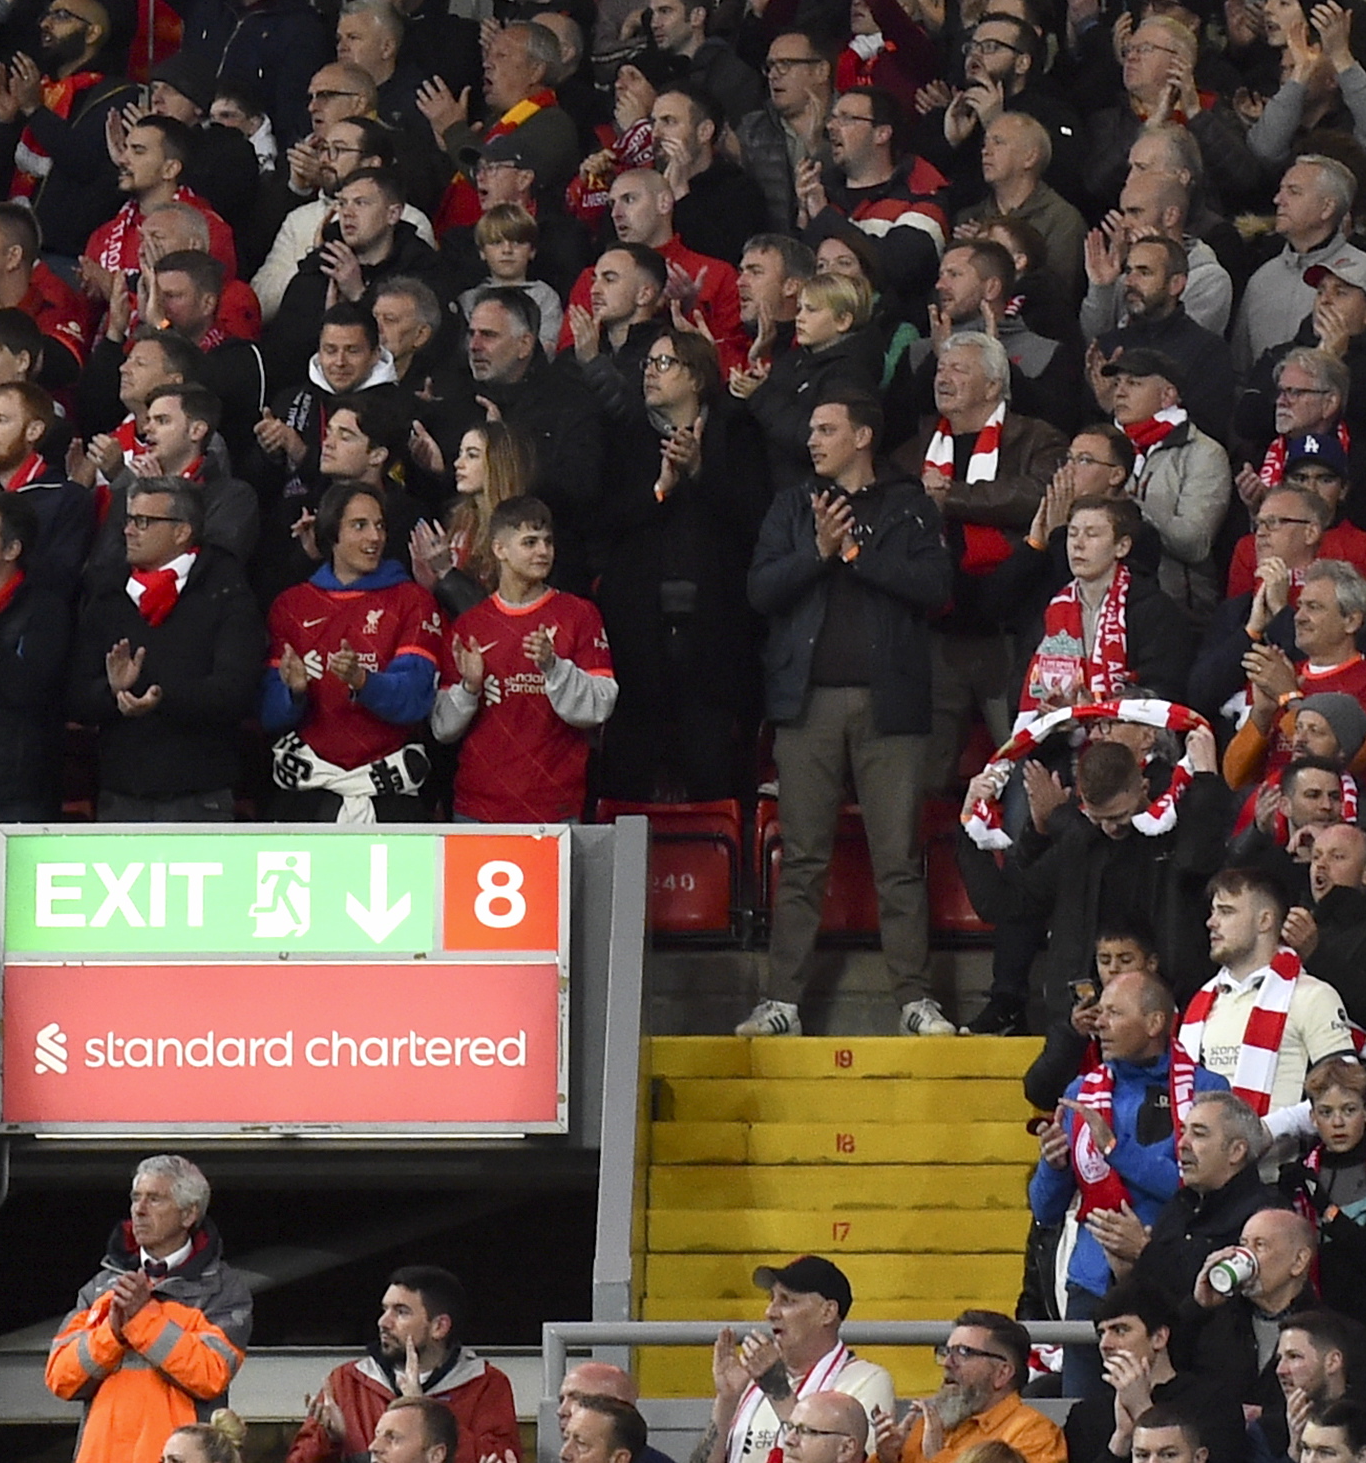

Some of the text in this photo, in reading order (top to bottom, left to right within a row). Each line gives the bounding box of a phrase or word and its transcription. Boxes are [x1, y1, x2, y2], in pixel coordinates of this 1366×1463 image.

[36, 860, 527, 929] EXIT 8
[85, 1031, 526, 1067] standard chartered
[834, 1049, 854, 1069] 19
[835, 1132, 855, 1154] 18
[832, 1221, 852, 1242] 17
